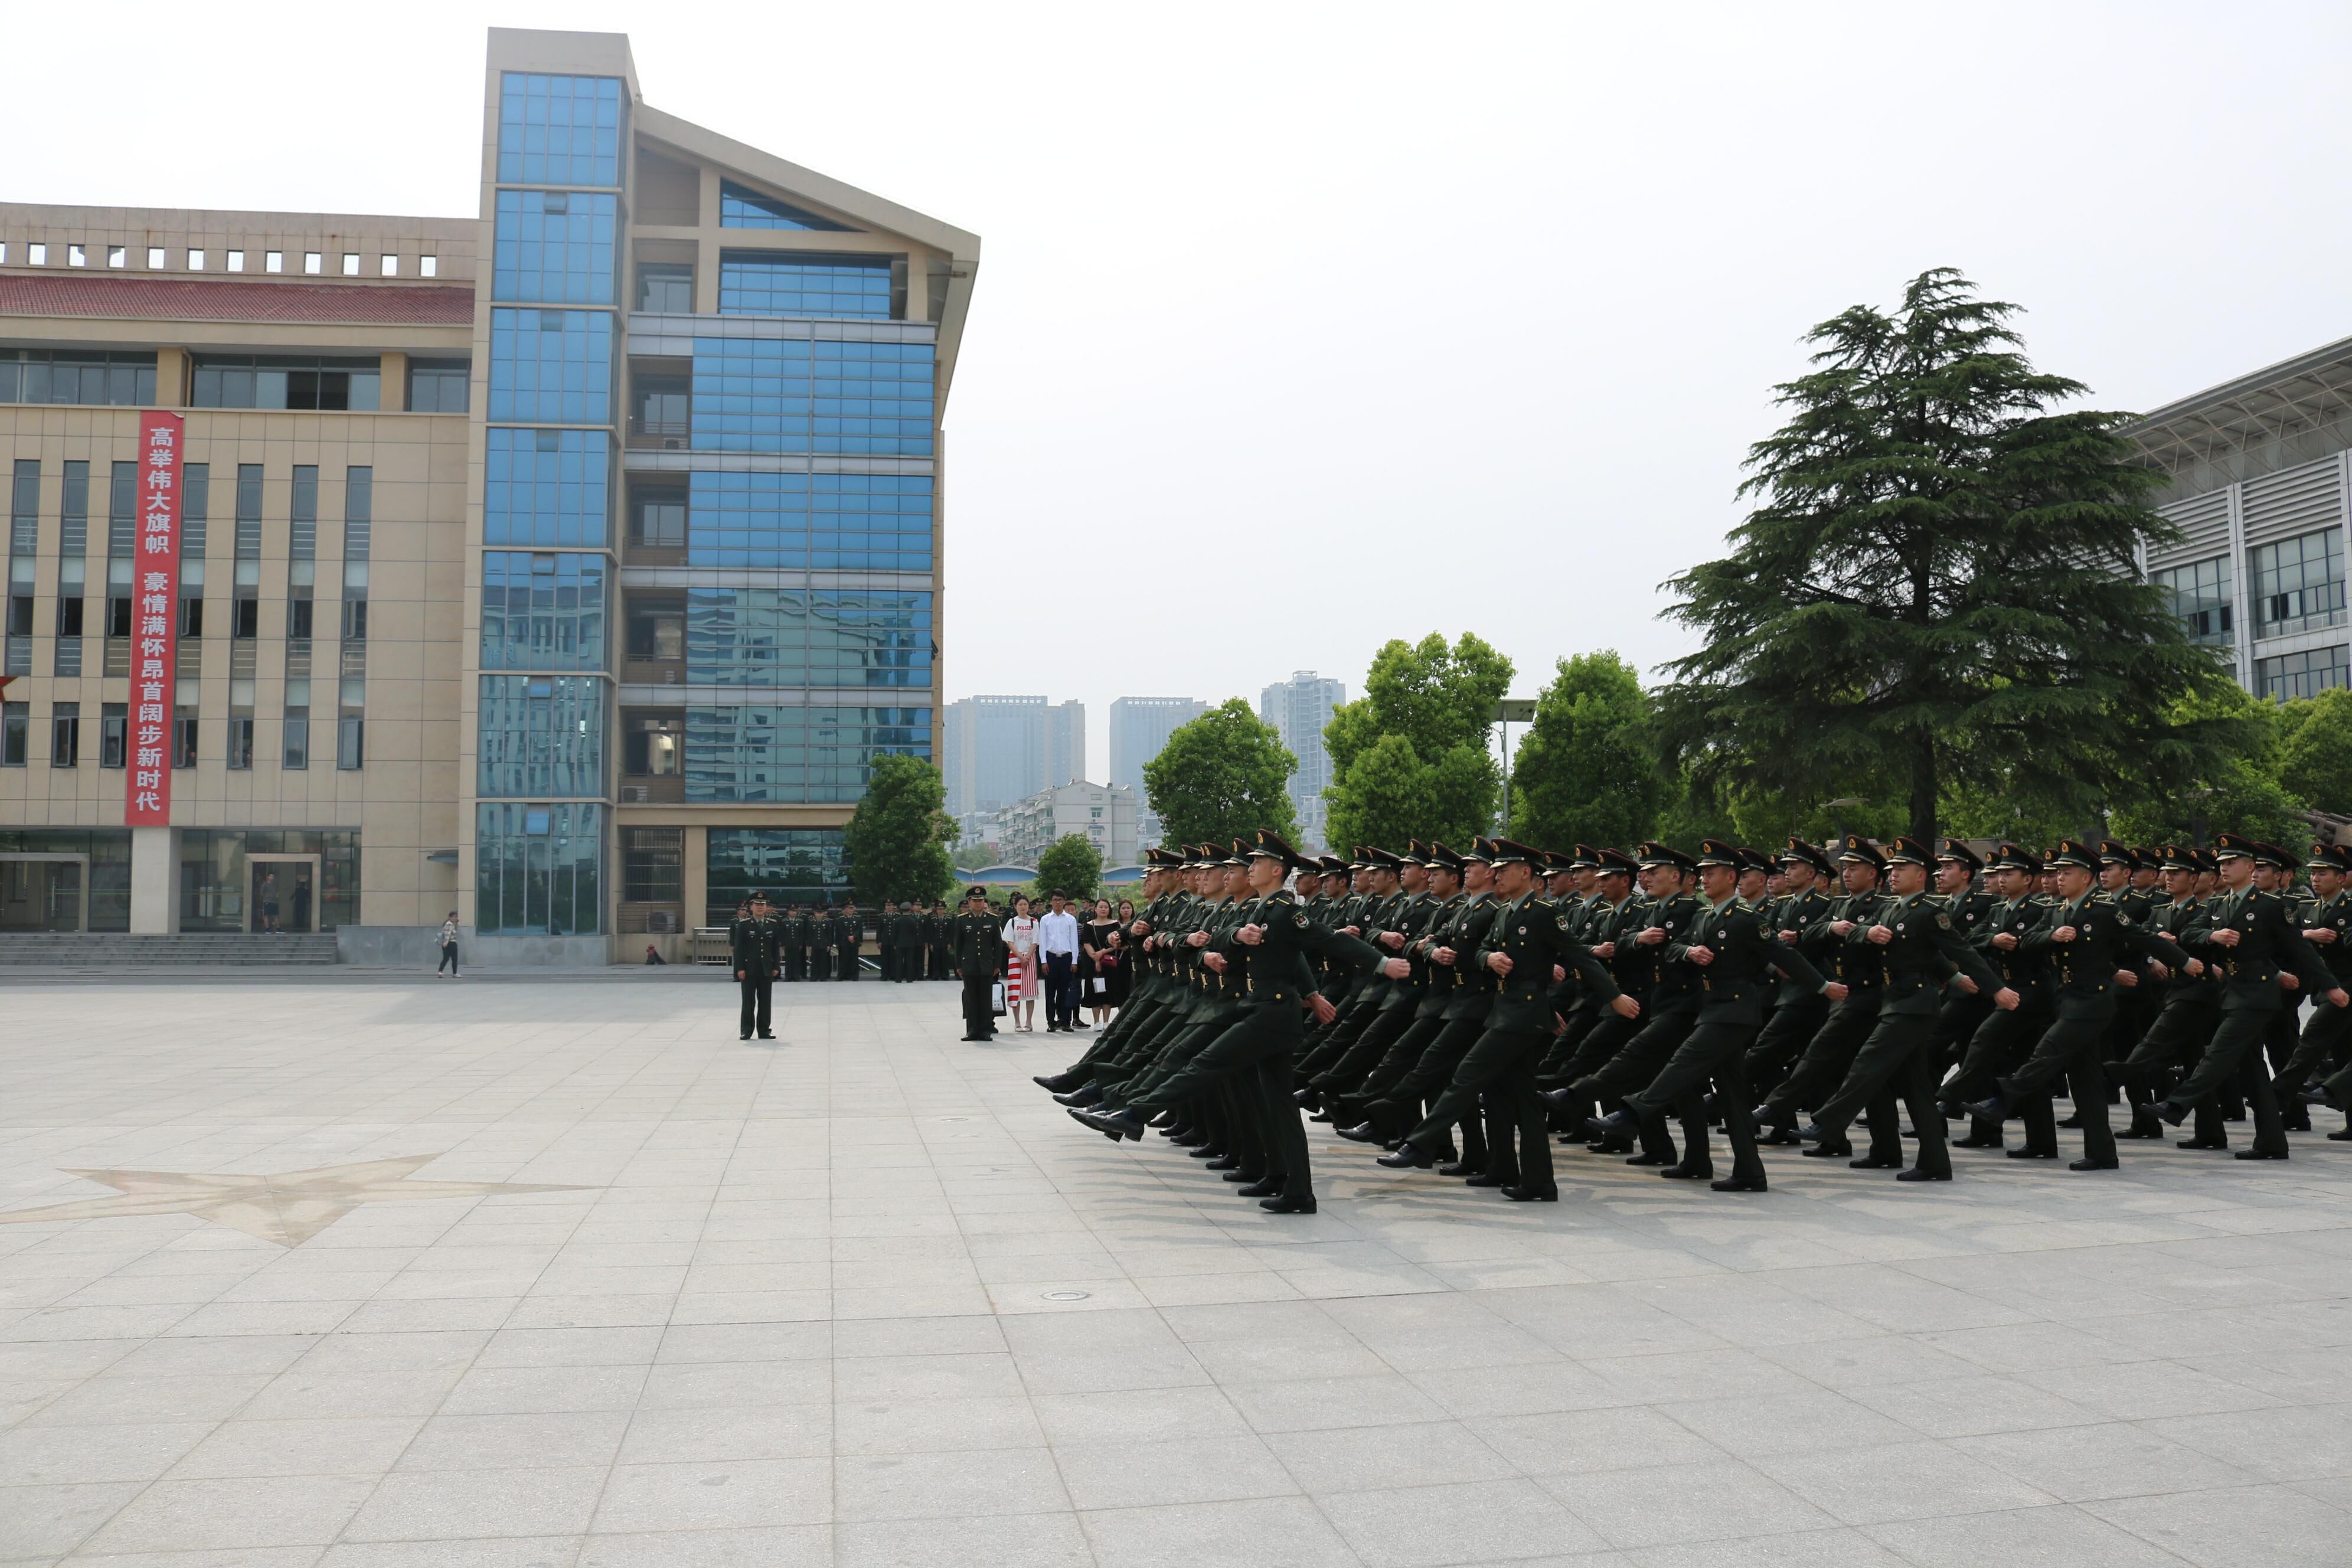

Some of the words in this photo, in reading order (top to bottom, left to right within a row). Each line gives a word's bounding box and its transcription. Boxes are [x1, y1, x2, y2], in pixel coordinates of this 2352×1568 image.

[145, 427, 174, 554] 高举伟大旗帜
[136, 572, 168, 811] 豪情满怀昂首阔步新时代
